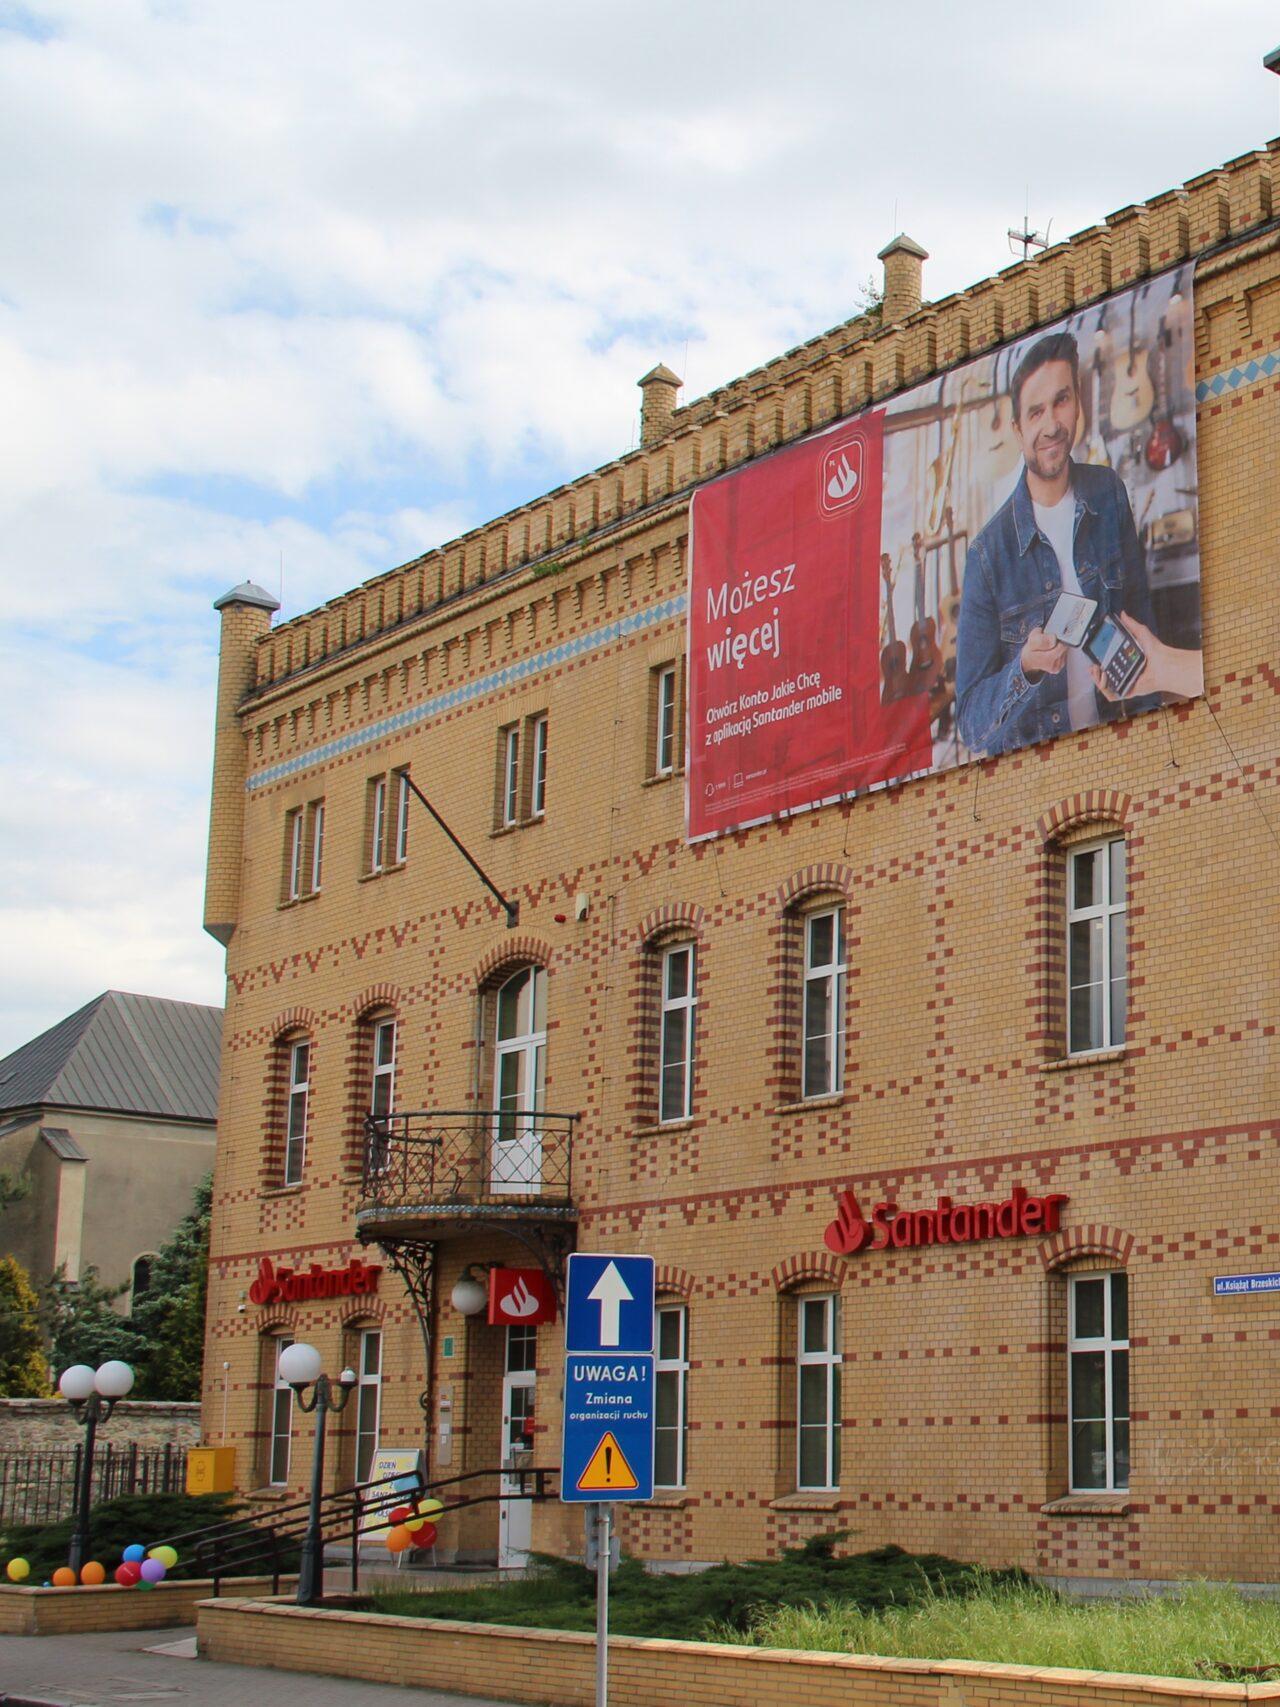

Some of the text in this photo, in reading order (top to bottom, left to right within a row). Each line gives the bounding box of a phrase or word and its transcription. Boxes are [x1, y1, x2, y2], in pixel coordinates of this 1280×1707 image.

[707, 563, 796, 624] Możesz
[706, 607, 780, 672] więcej
[705, 685, 842, 746] z aplikacją Santander mobile
[706, 672, 821, 724] Otwórz Konto Jakie Chcę
[870, 1187, 1070, 1249] Santander
[574, 1365, 646, 1382] UWAGA!
[585, 1392, 633, 1405] Zmiana
[569, 1410, 648, 1421] organizacji ruchu
